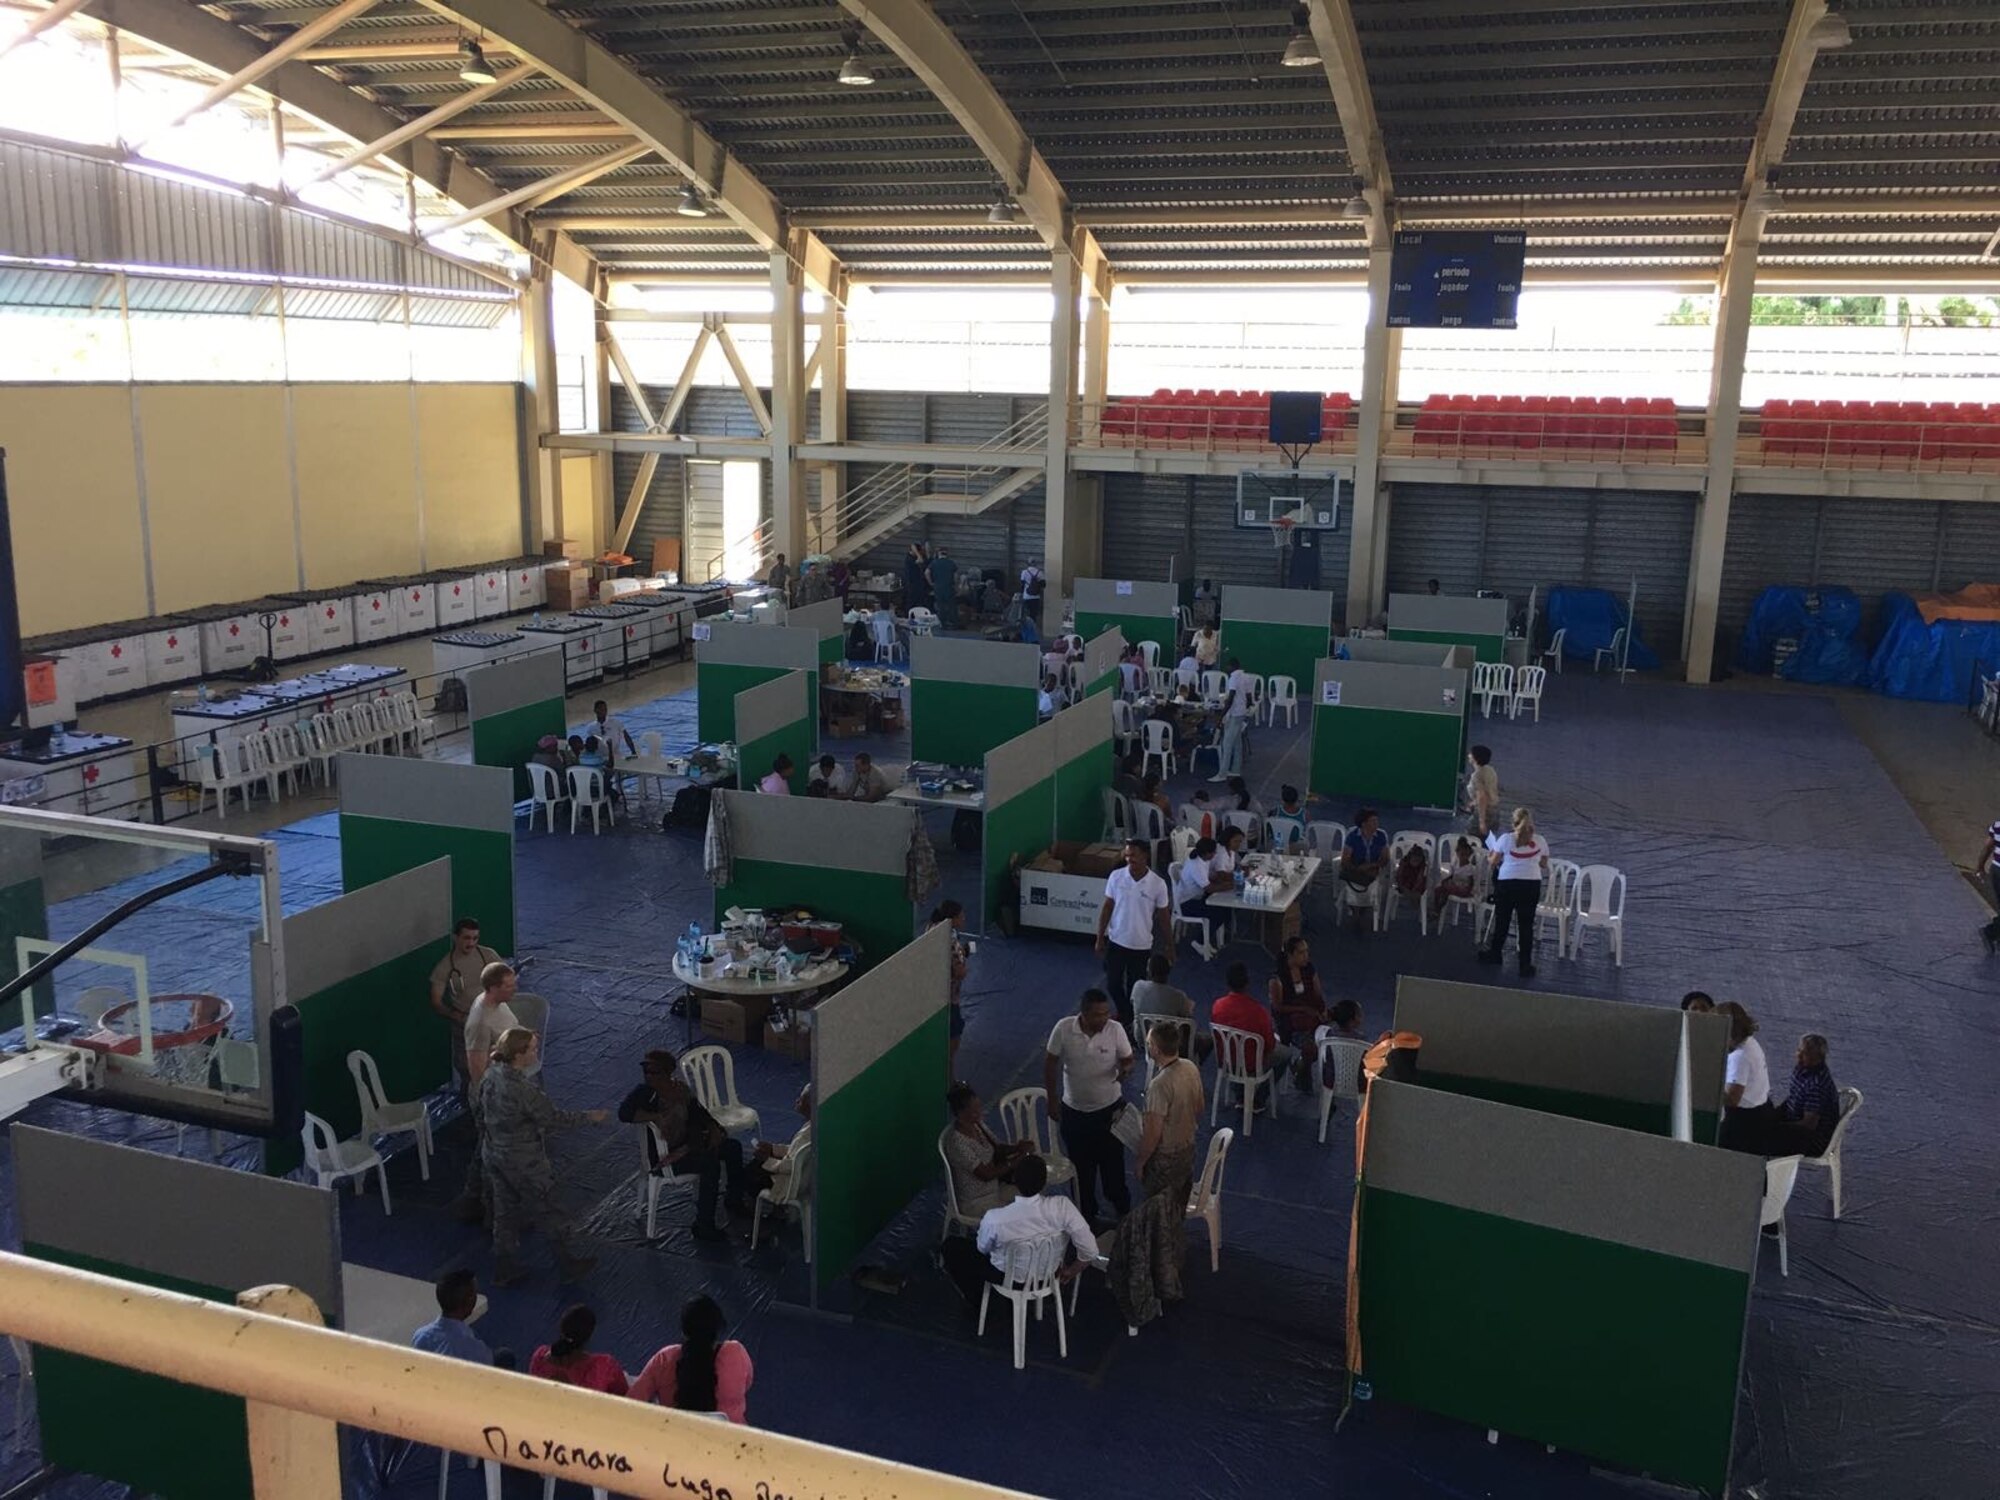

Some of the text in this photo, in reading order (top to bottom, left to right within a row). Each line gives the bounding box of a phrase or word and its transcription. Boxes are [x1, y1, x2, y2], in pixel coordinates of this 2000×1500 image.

[1400, 234, 1422, 244] Local
[1441, 267, 1470, 277] periodo
[1440, 282, 1469, 292] jugador
[1441, 316, 1462, 326] juego
